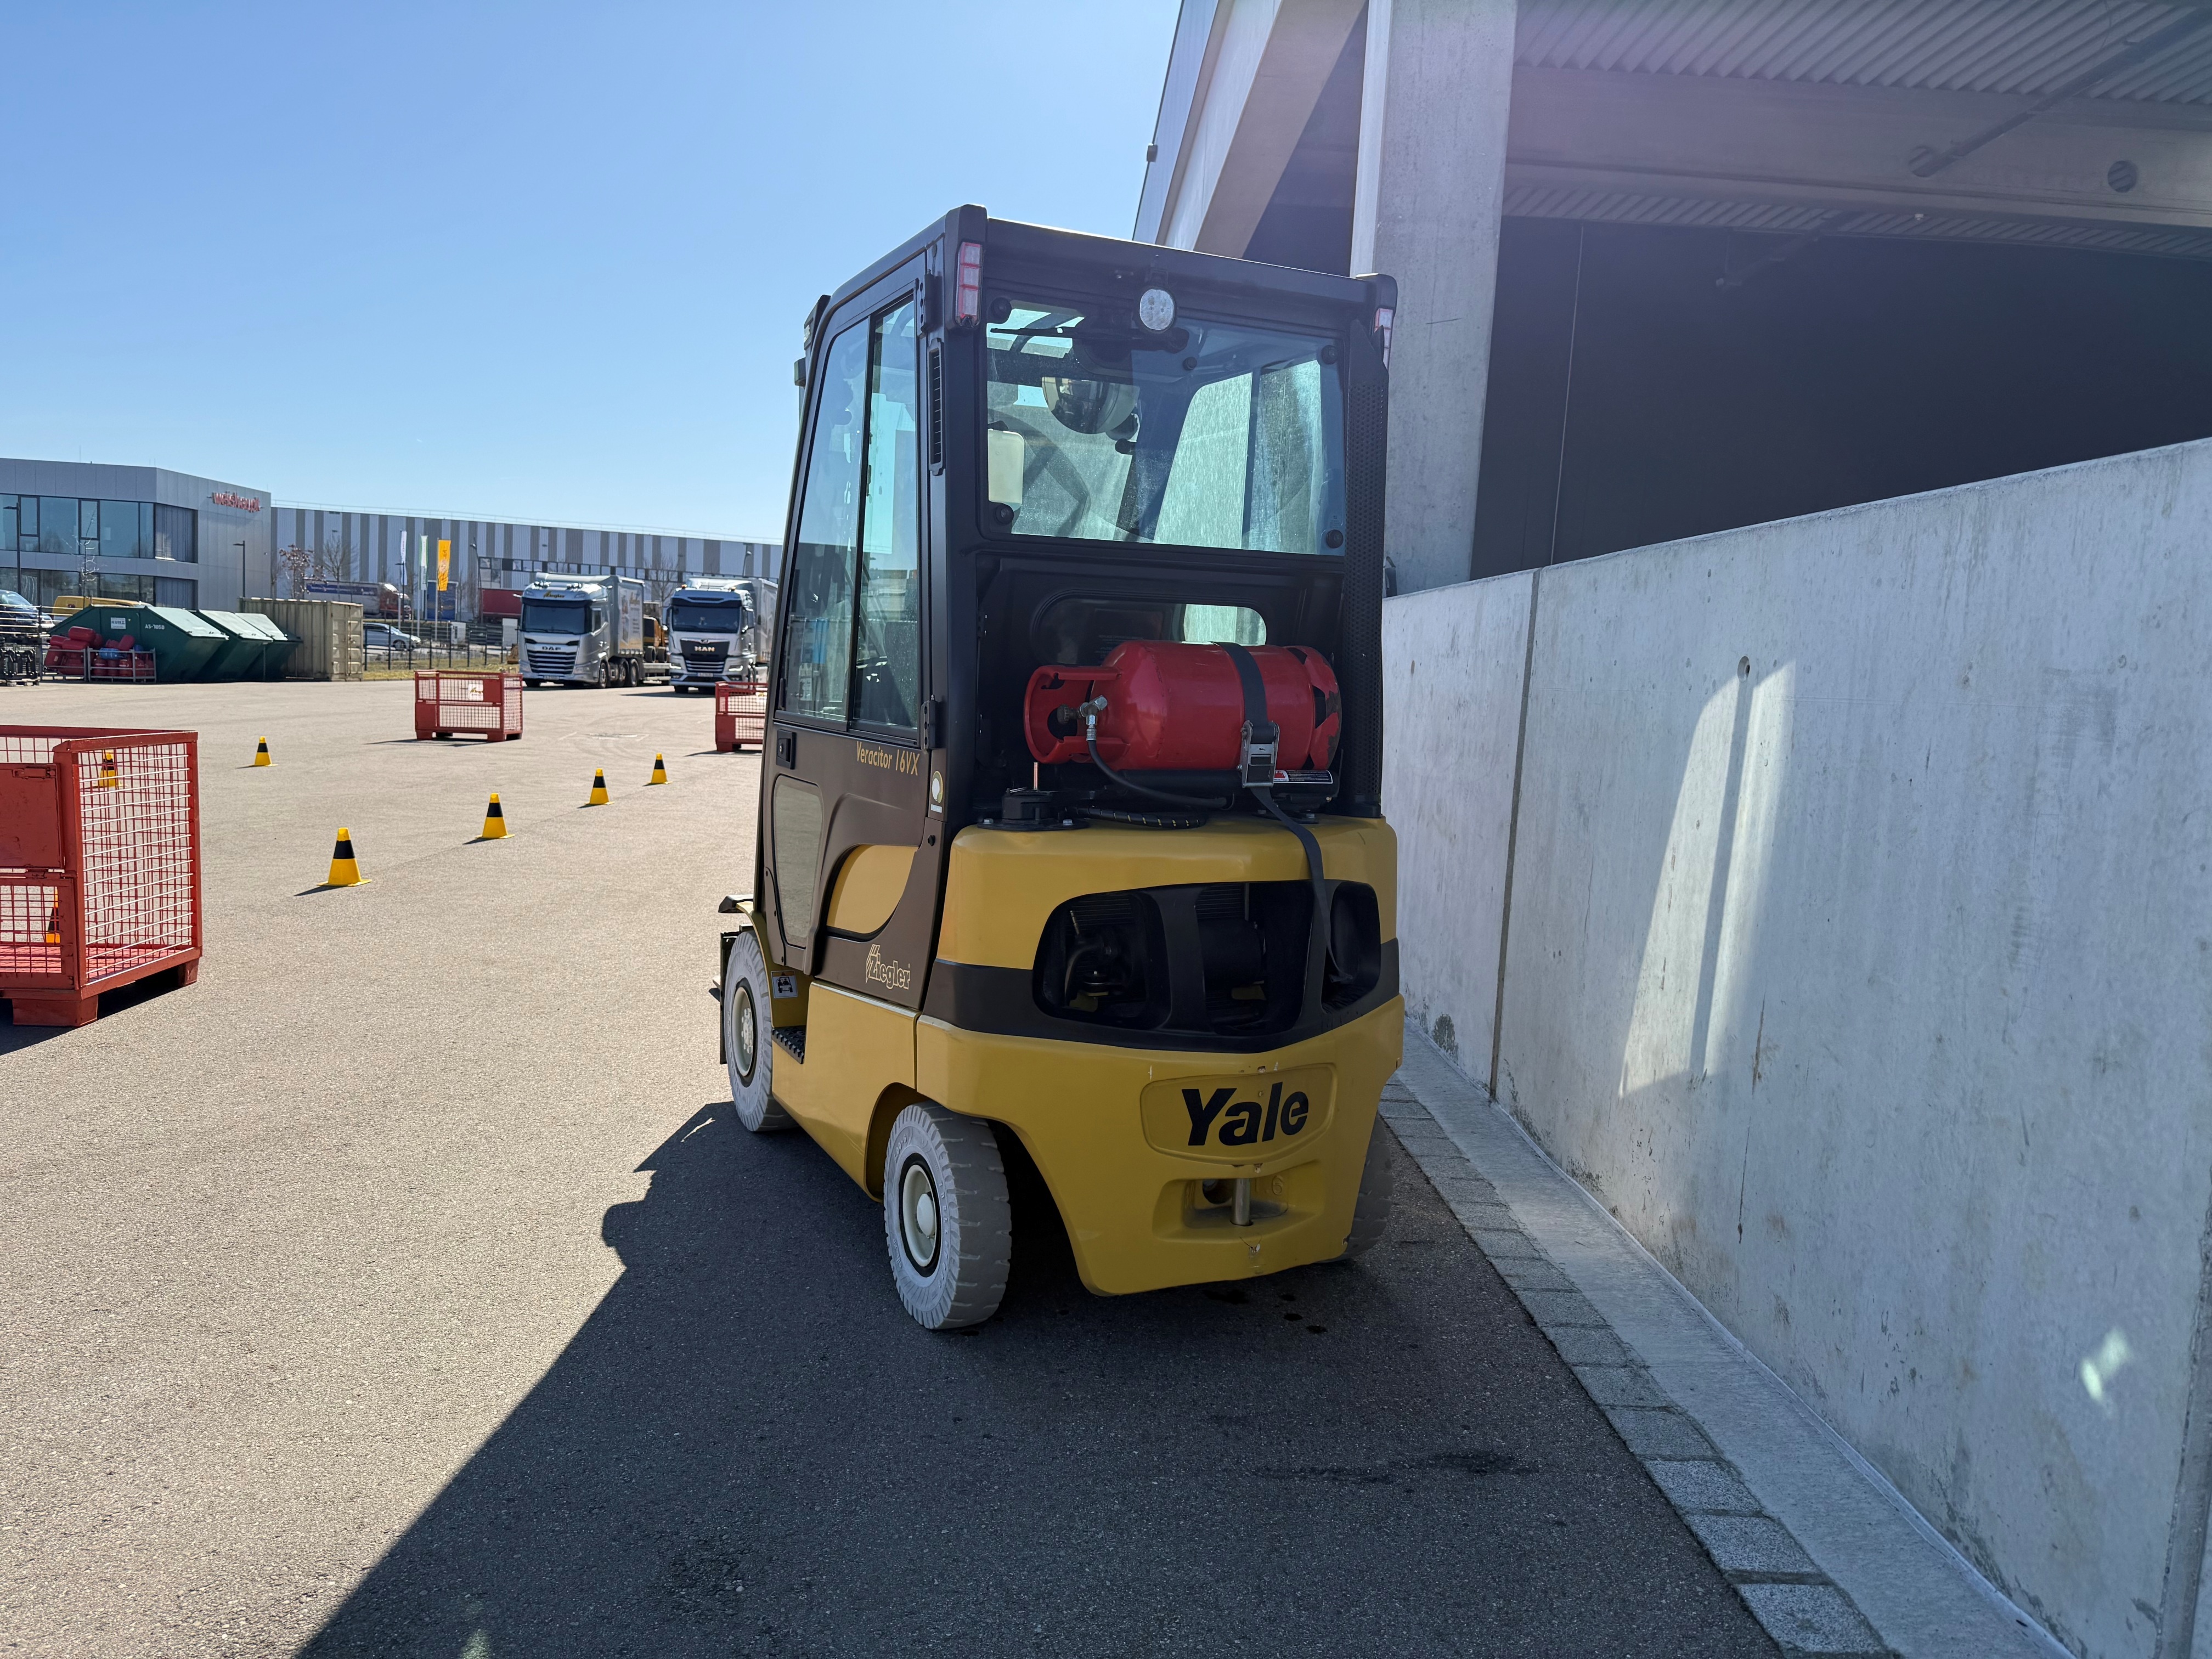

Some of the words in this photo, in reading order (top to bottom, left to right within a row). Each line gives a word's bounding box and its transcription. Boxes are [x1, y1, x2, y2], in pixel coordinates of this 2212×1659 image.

[856, 741, 893, 769] Veracitor
[895, 749, 920, 776] 16VX
[1182, 1082, 1309, 1146] Yale
